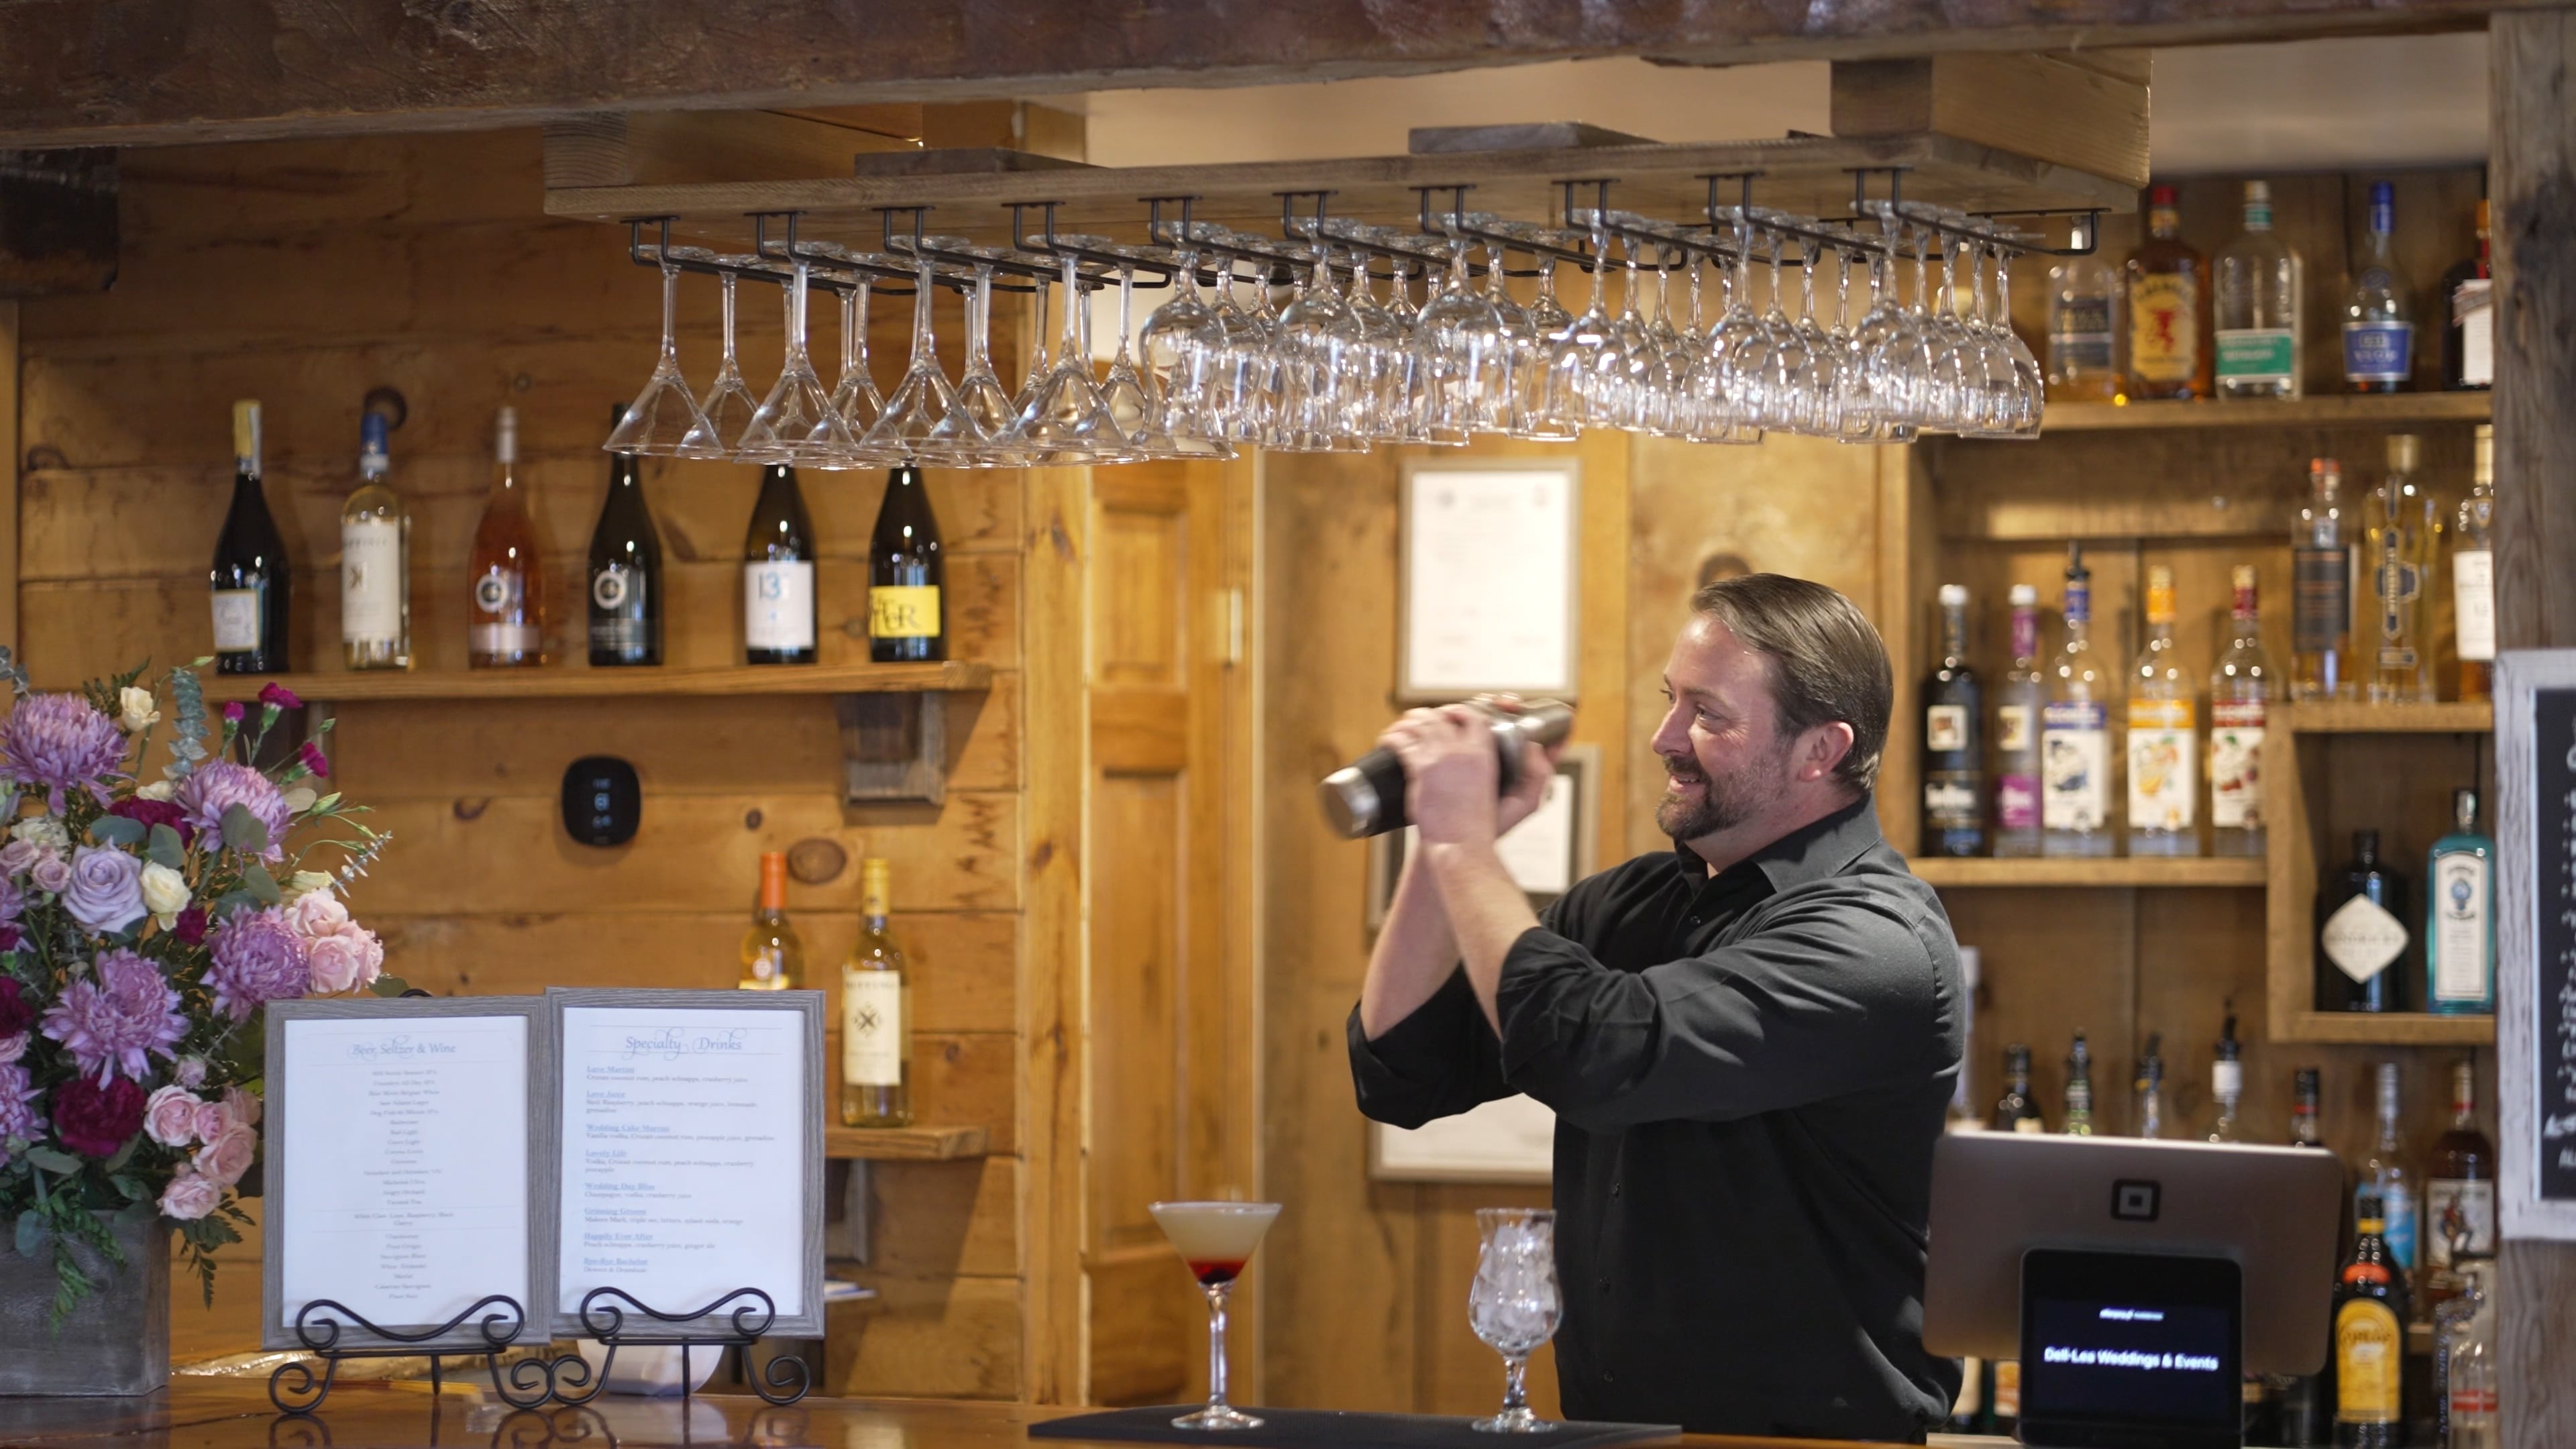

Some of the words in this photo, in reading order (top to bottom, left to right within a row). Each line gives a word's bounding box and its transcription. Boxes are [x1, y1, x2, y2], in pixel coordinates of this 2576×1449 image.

[380, 1035, 415, 1057] Seltzer
[417, 1042, 426, 1053] &
[428, 1042, 456, 1053] Wine
[623, 1028, 684, 1059] Specialty
[694, 1028, 747, 1053] Drinks
[2097, 1348, 2160, 1370] Weddings
[2161, 1352, 2173, 1368] &
[2174, 1352, 2220, 1371] Events
